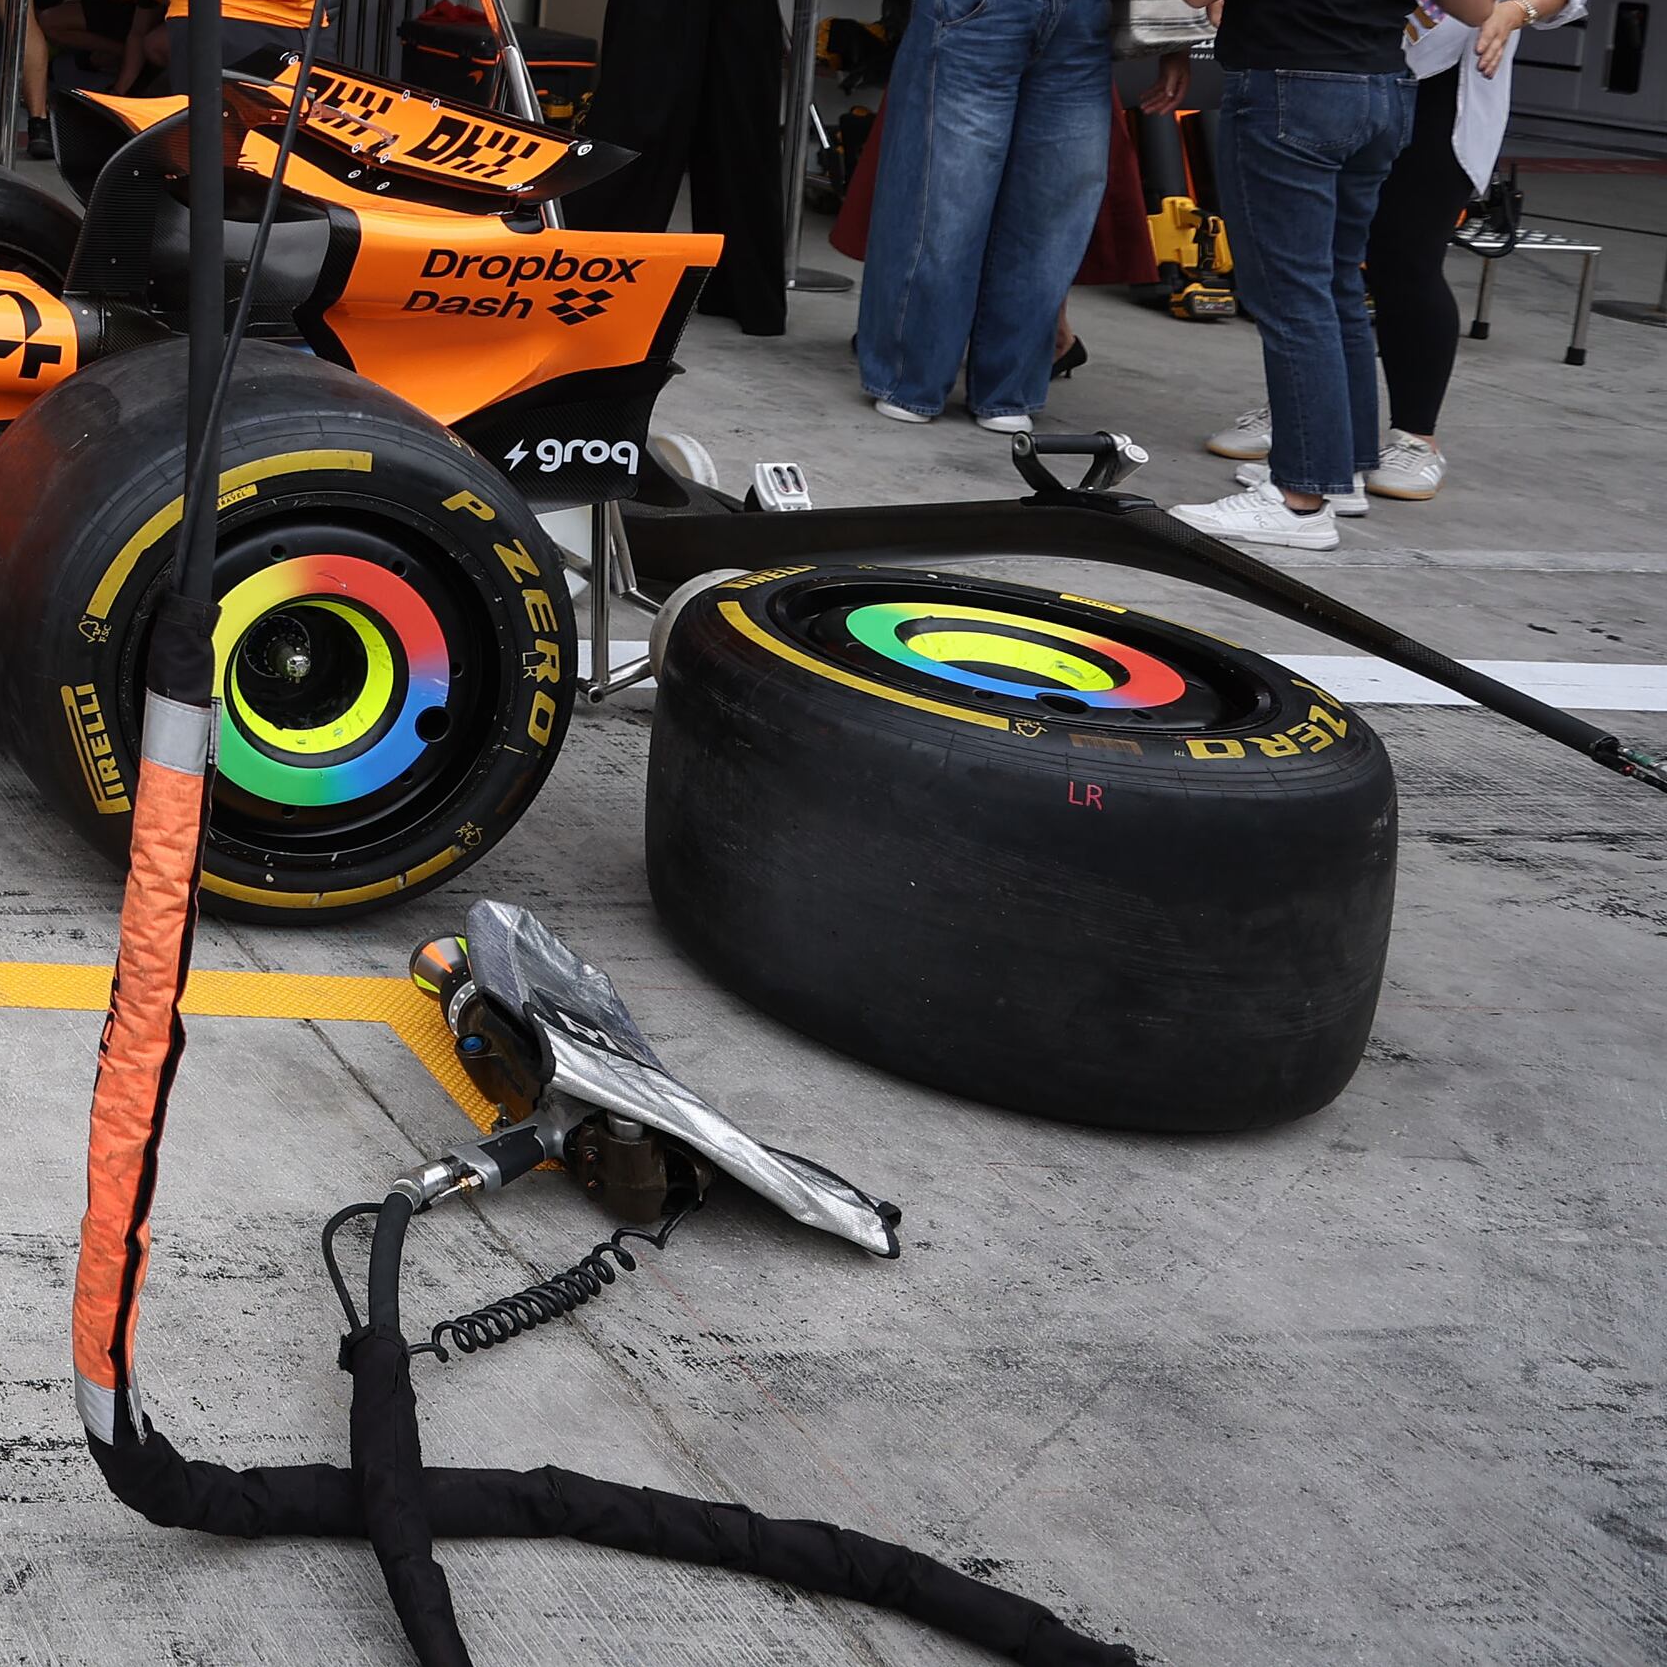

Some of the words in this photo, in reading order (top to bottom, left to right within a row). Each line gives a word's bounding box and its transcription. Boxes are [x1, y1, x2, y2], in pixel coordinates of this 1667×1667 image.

[420, 248, 647, 289] Dropbox
[403, 288, 534, 321] Dash
[538, 438, 640, 476] groq
[719, 564, 817, 590] PIRELLI
[441, 489, 496, 522] P
[493, 541, 561, 747] ZERO
[60, 683, 132, 815] PIRELLI
[1188, 702, 1349, 760] ZERO
[1067, 781, 1103, 811] LR
